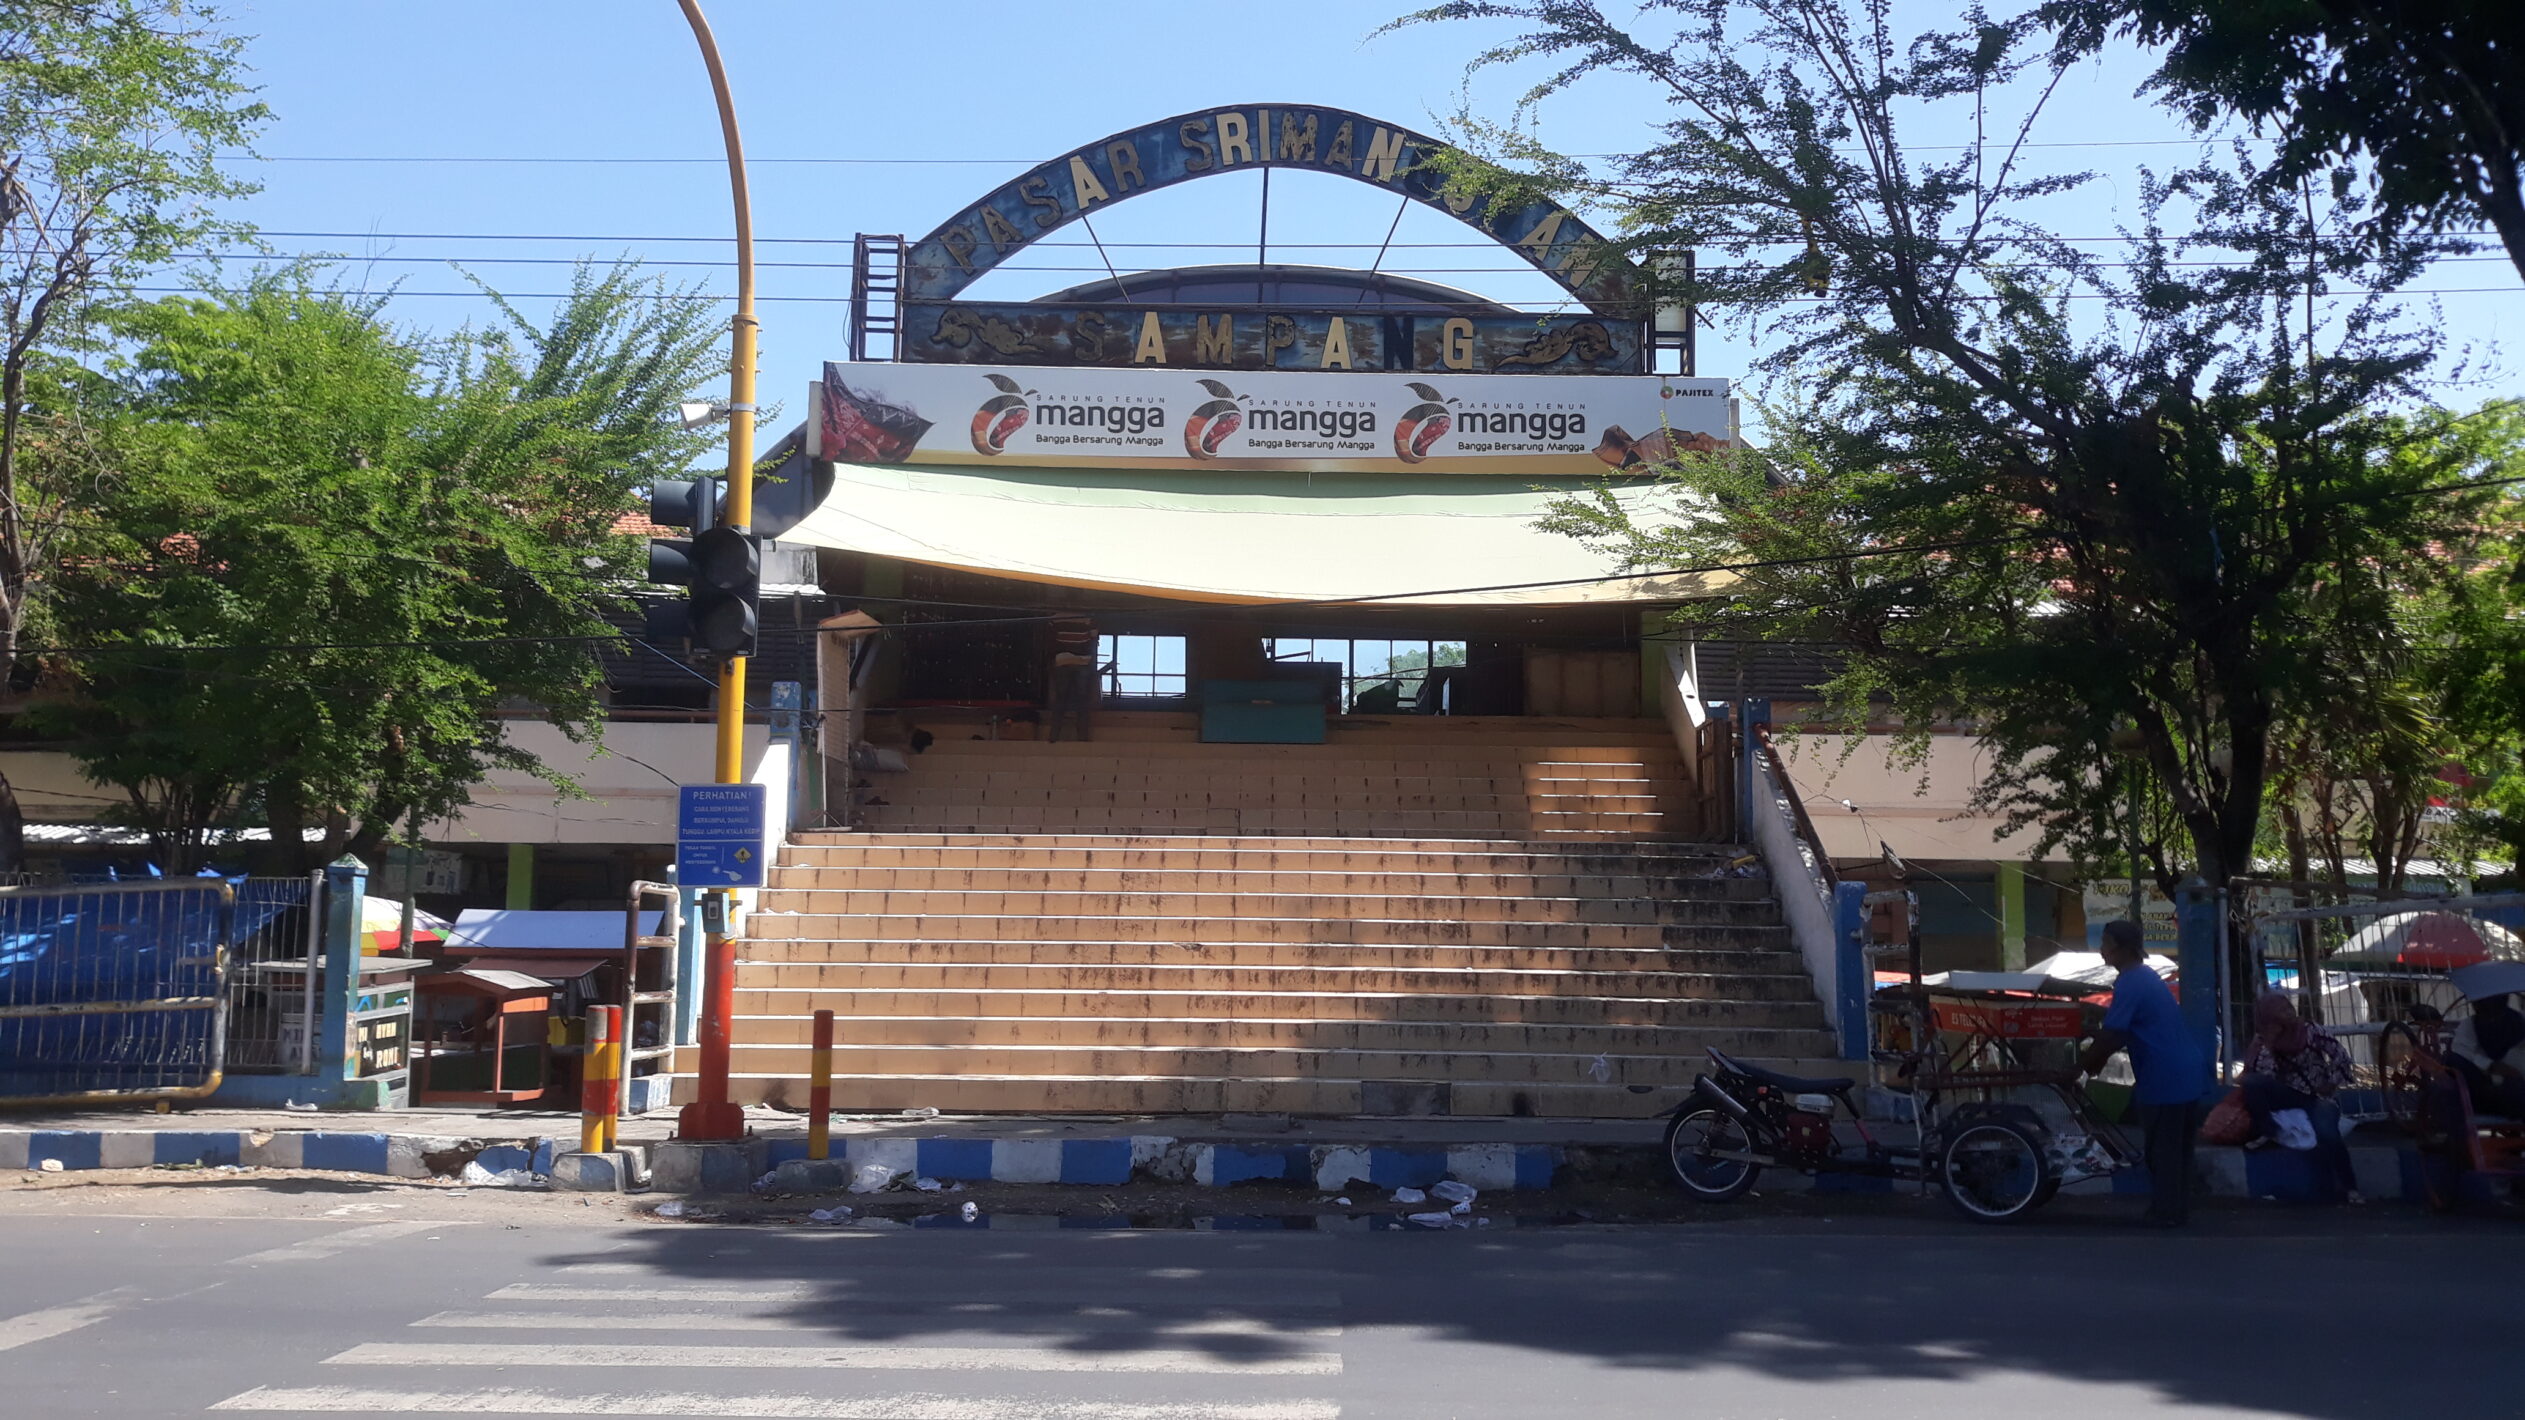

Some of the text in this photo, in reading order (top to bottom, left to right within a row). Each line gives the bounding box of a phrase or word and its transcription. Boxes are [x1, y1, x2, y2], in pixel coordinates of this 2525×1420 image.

[939, 139, 1146, 276] PASAR
[1073, 310, 1474, 370] SAMPANG
[1036, 394, 1166, 404] SARUNG TENUN
[1676, 389, 1714, 397] PAJITEX
[1248, 399, 1315, 407] SARUNG
[1457, 402, 1525, 410] SARUNG
[1036, 404, 1165, 434] mangga
[1248, 409, 1376, 438] mangga
[1458, 412, 1585, 440] mangga
[1036, 434, 1164, 446] Bangga Bersarung Mangga
[1248, 438, 1375, 450] Bangga Bersarung Mangga
[1458, 441, 1585, 452] Bangga Bersarung Mangga
